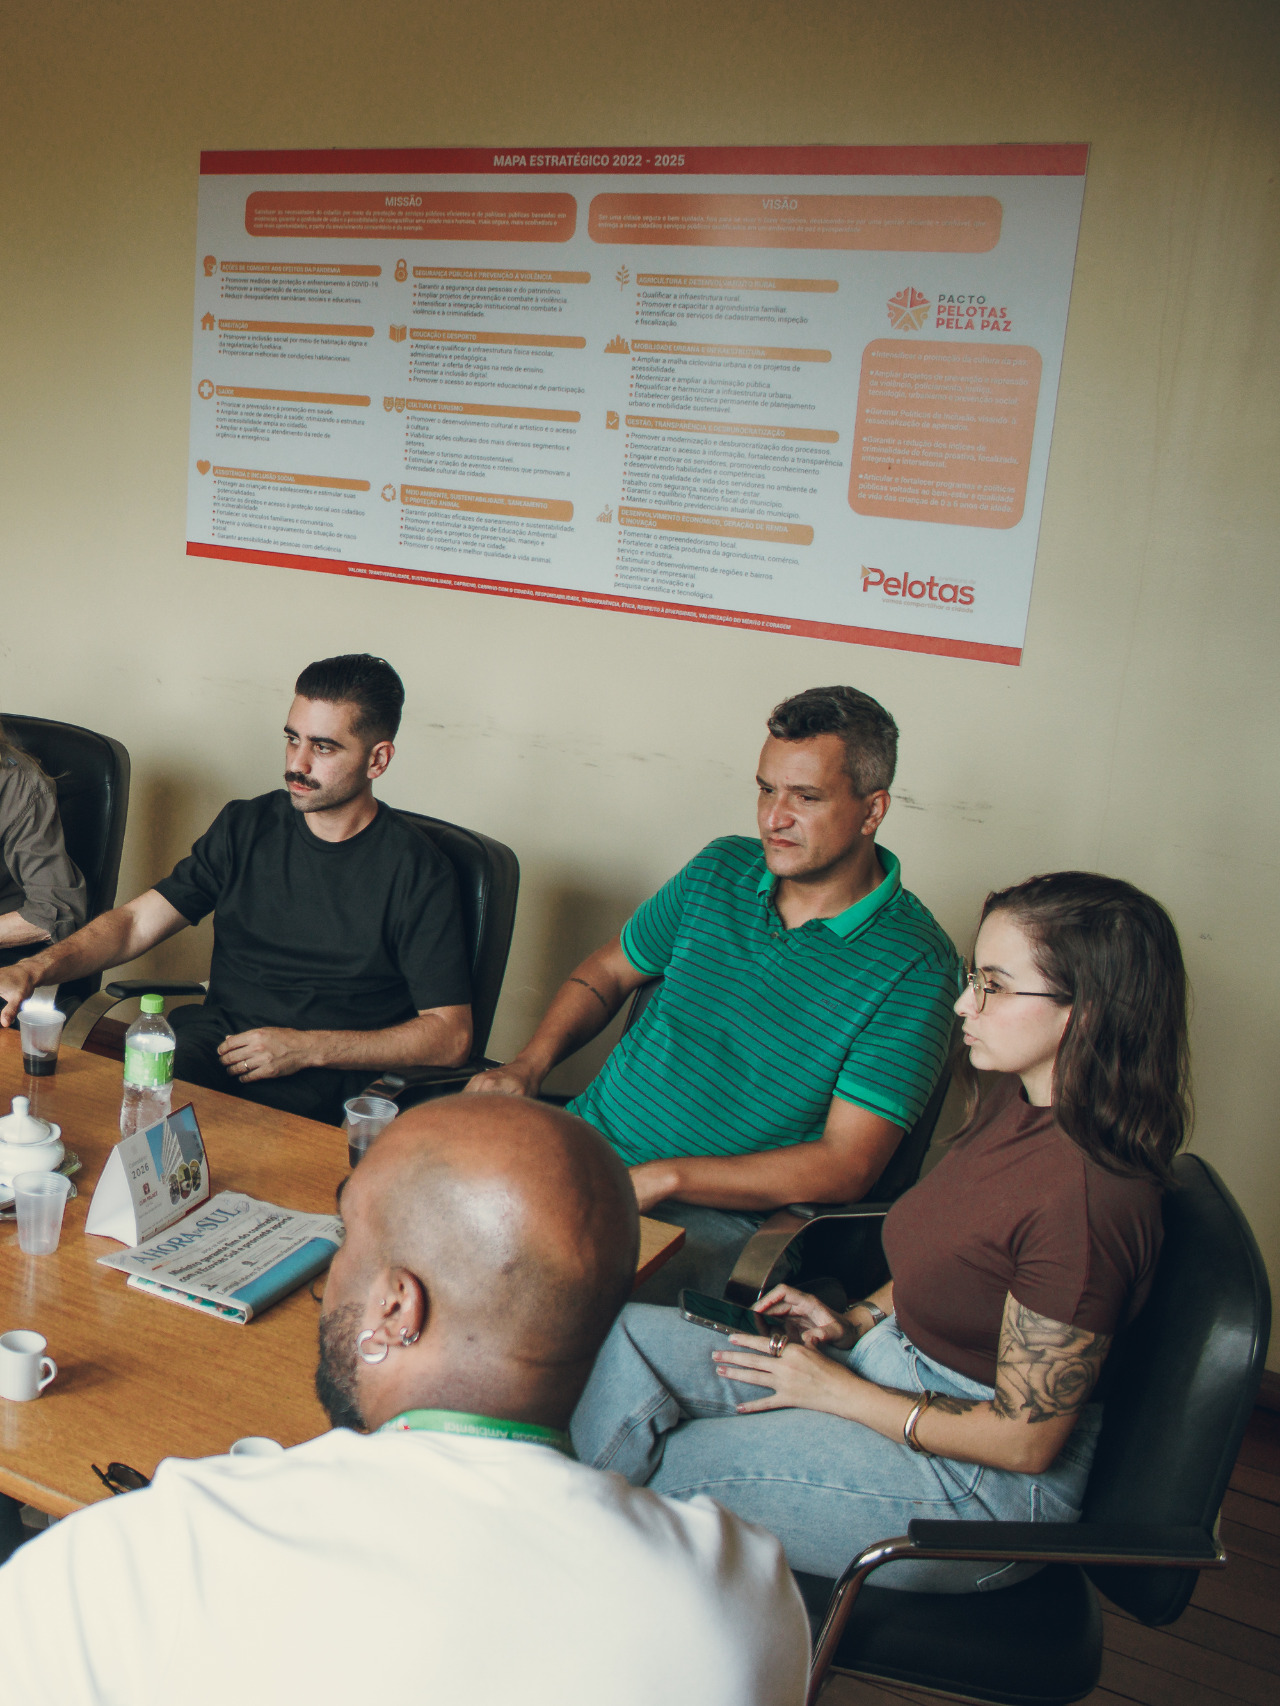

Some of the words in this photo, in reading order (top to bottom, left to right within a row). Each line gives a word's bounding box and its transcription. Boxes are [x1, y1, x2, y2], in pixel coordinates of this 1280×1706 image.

[493, 155, 526, 167] MAPA
[529, 152, 609, 167] ESTRATÉGICO
[612, 155, 642, 166] 2022
[654, 154, 685, 166] 2025
[385, 194, 422, 206] MISSÃO
[762, 197, 798, 210] VISÃO
[938, 294, 986, 304] PACTO
[937, 305, 1008, 318] PELOTAS
[936, 318, 975, 330] PELA
[981, 320, 1012, 332] PAZ
[862, 566, 975, 605] Pelotas
[132, 1162, 150, 1180] 2026
[196, 1208, 241, 1230] SUL
